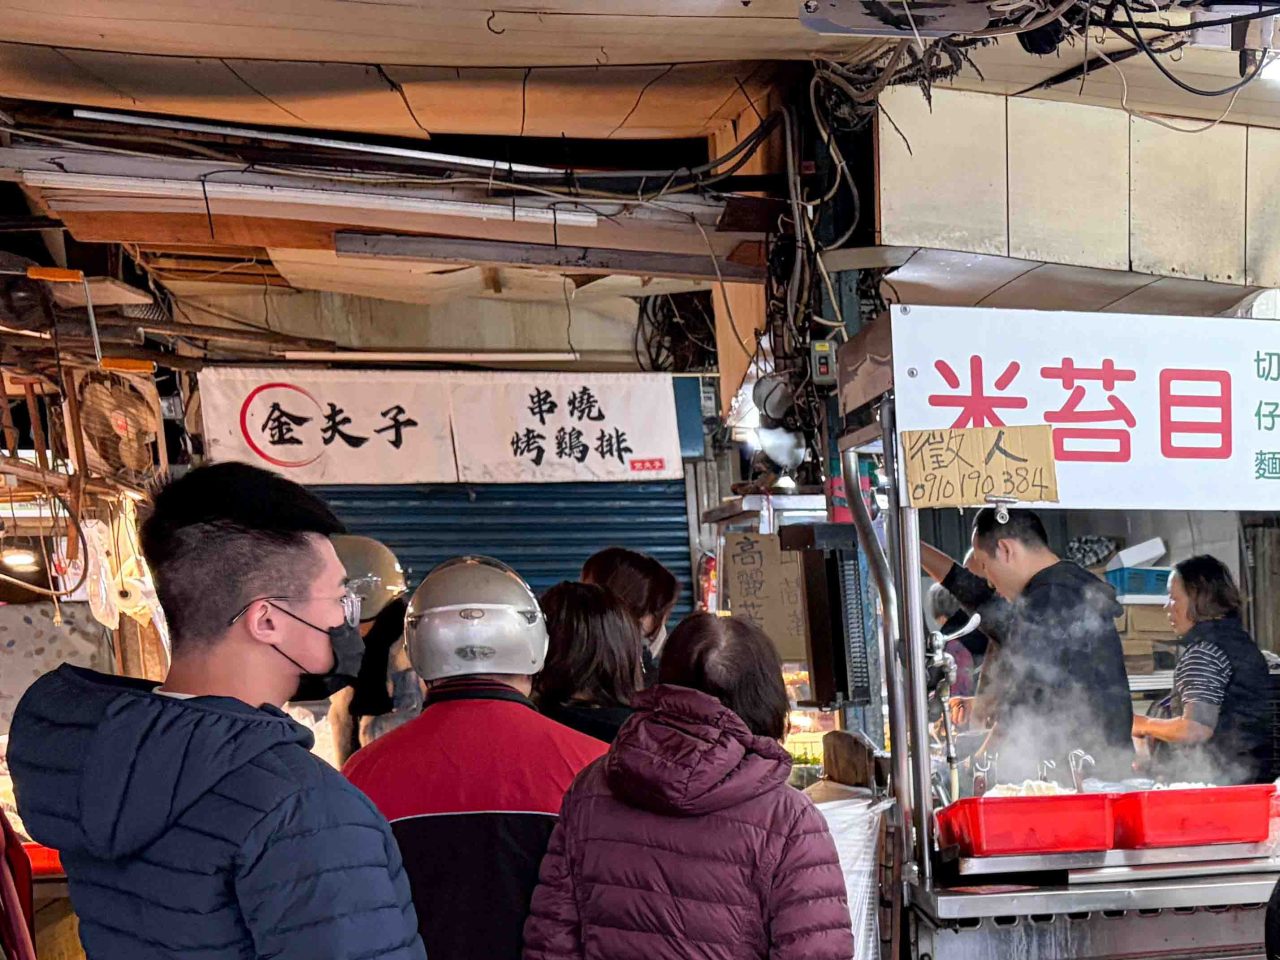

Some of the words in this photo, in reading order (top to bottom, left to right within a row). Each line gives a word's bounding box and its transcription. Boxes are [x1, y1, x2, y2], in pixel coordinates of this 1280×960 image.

[261, 402, 419, 448] 金夫子
[527, 385, 606, 426] 串燒
[928, 355, 1232, 462] 米苔目
